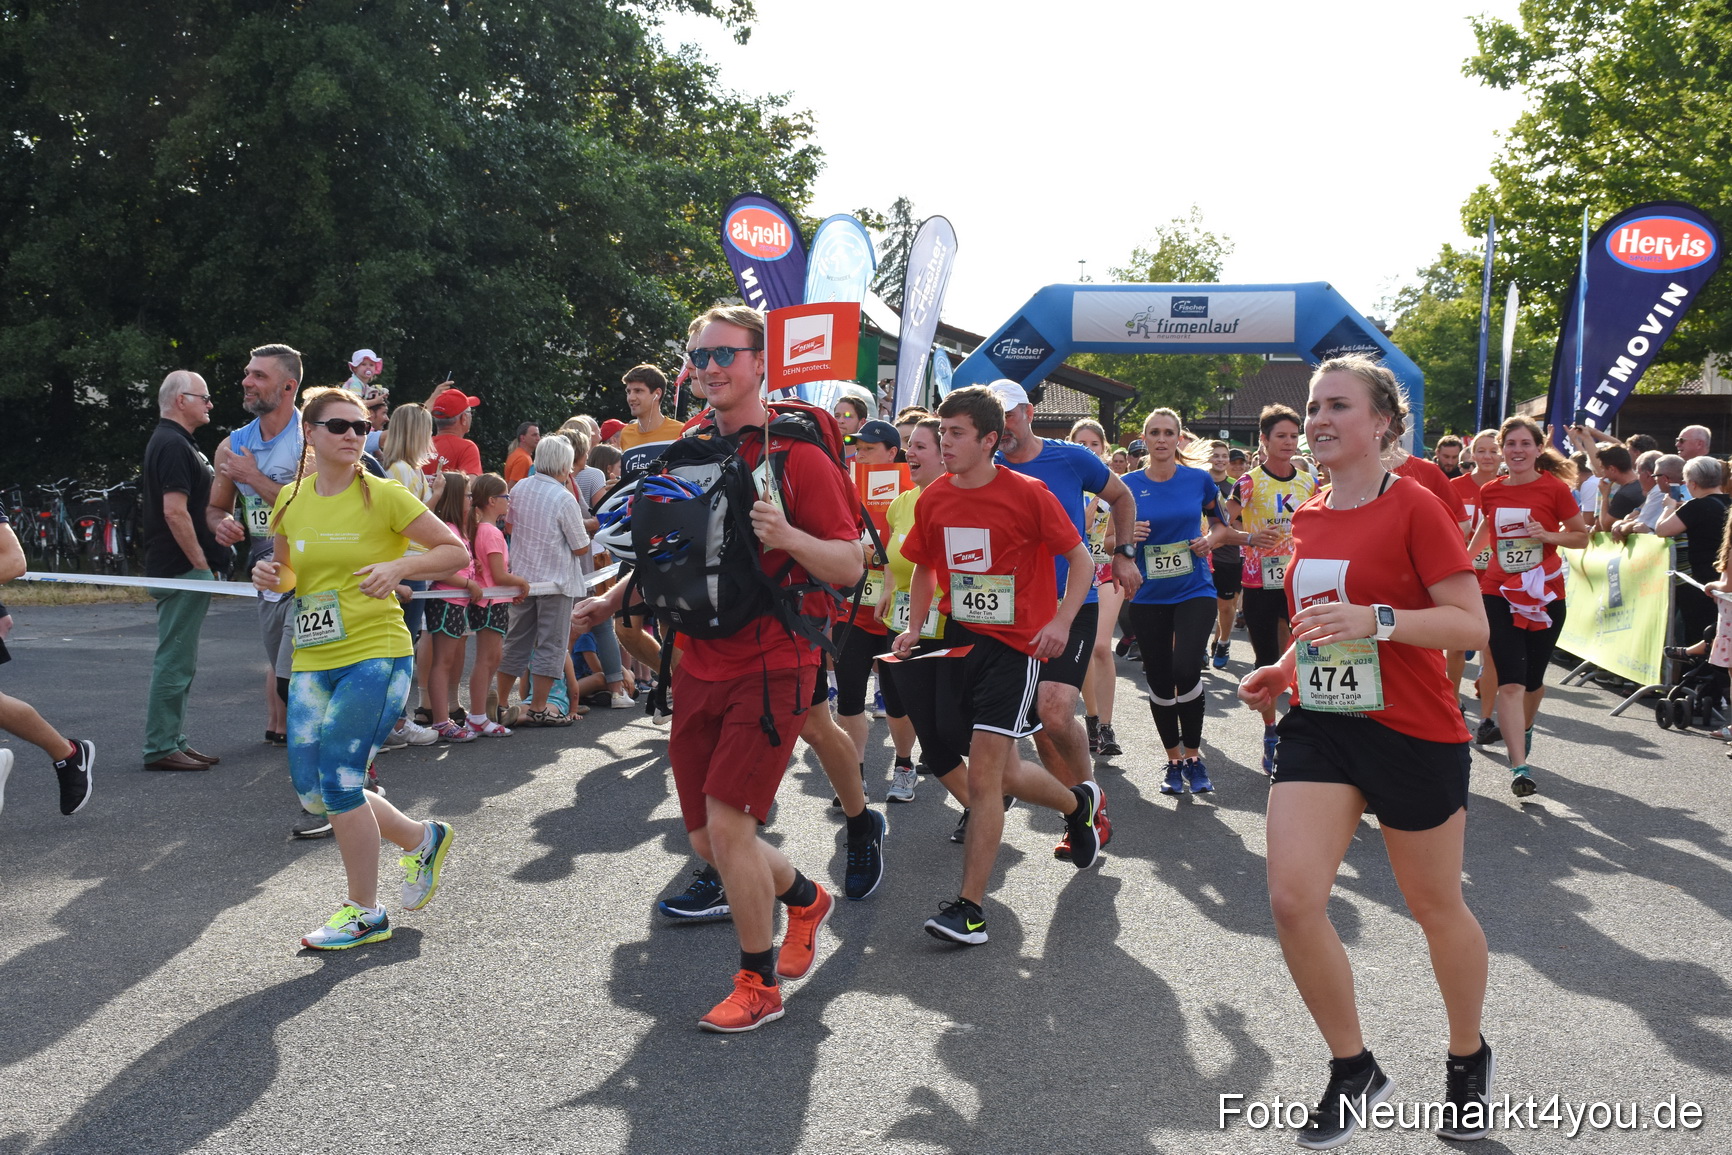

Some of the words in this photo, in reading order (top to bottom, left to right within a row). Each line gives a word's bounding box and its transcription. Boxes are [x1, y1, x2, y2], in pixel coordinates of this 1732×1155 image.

[1618, 228, 1706, 261] Hervis
[1628, 254, 1663, 263] SPORTS
[928, 245, 947, 308] AUTOMOBILE
[1177, 302, 1206, 312] Fischer
[1156, 318, 1240, 334] firmenlauf
[998, 340, 1045, 355] Fischer
[782, 366, 801, 376] DEHN
[801, 363, 831, 373] protects.
[961, 552, 976, 561] DEHN
[1155, 554, 1182, 570] 576
[1506, 550, 1533, 564] 527
[962, 591, 999, 611] 463
[1312, 595, 1330, 606] DEHN
[296, 609, 334, 634] 1224
[312, 628, 336, 637] Stephanie
[1354, 657, 1373, 665] 2019
[1309, 665, 1359, 692] 474
[1310, 692, 1340, 701] Deininger
[1340, 692, 1362, 701] Tanja
